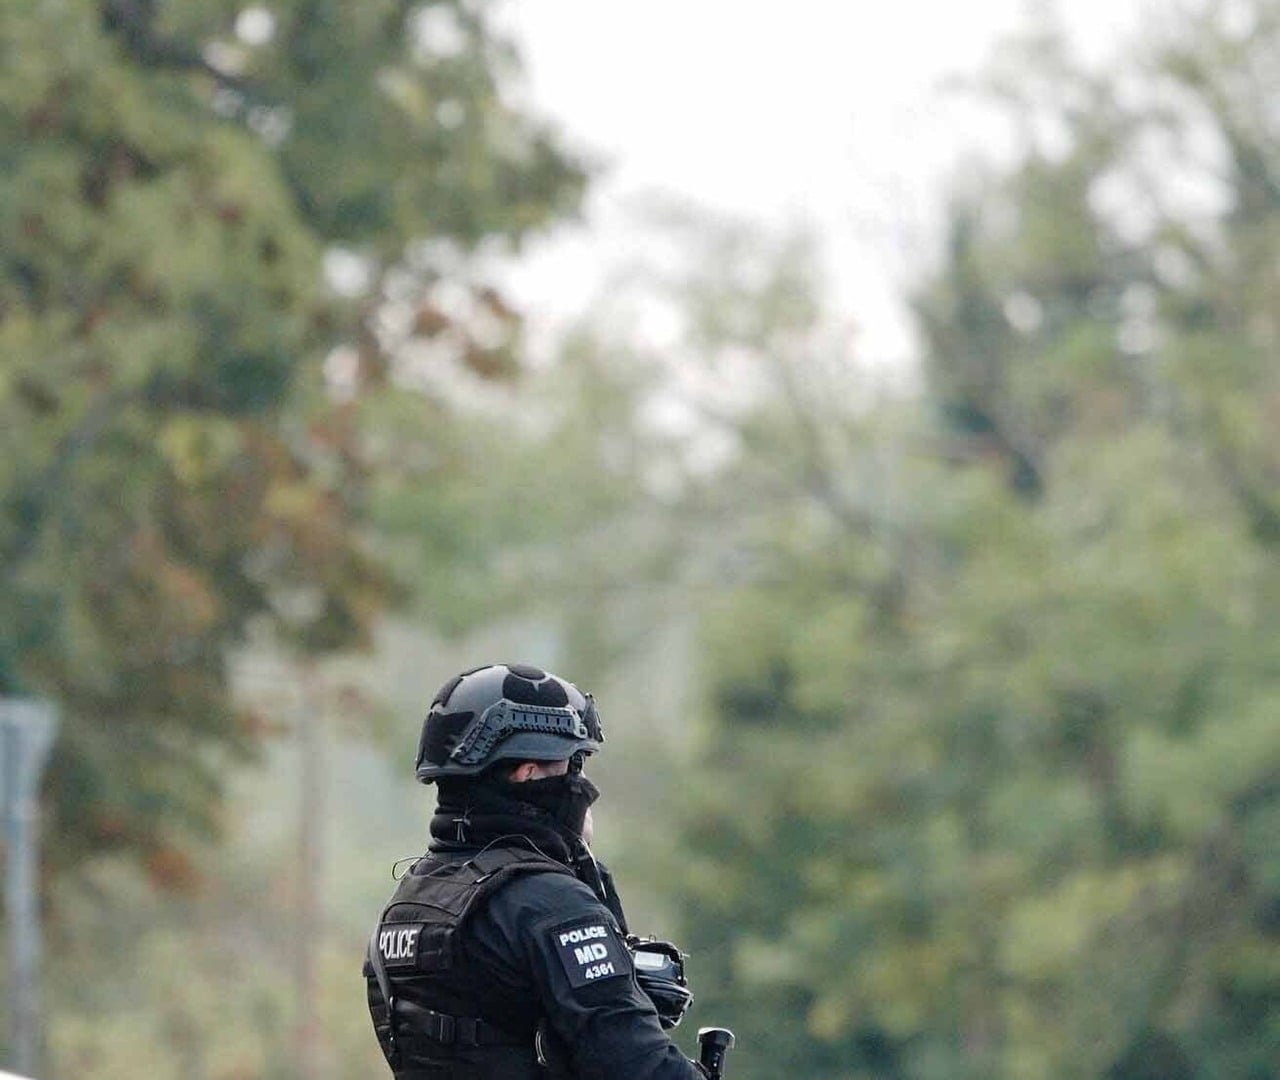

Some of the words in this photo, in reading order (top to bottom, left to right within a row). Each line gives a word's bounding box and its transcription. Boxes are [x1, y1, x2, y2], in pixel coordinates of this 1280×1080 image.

[380, 929, 417, 959] POLICE
[559, 926, 608, 946] POLICE
[574, 943, 608, 965] MD
[585, 962, 615, 979] 4361
